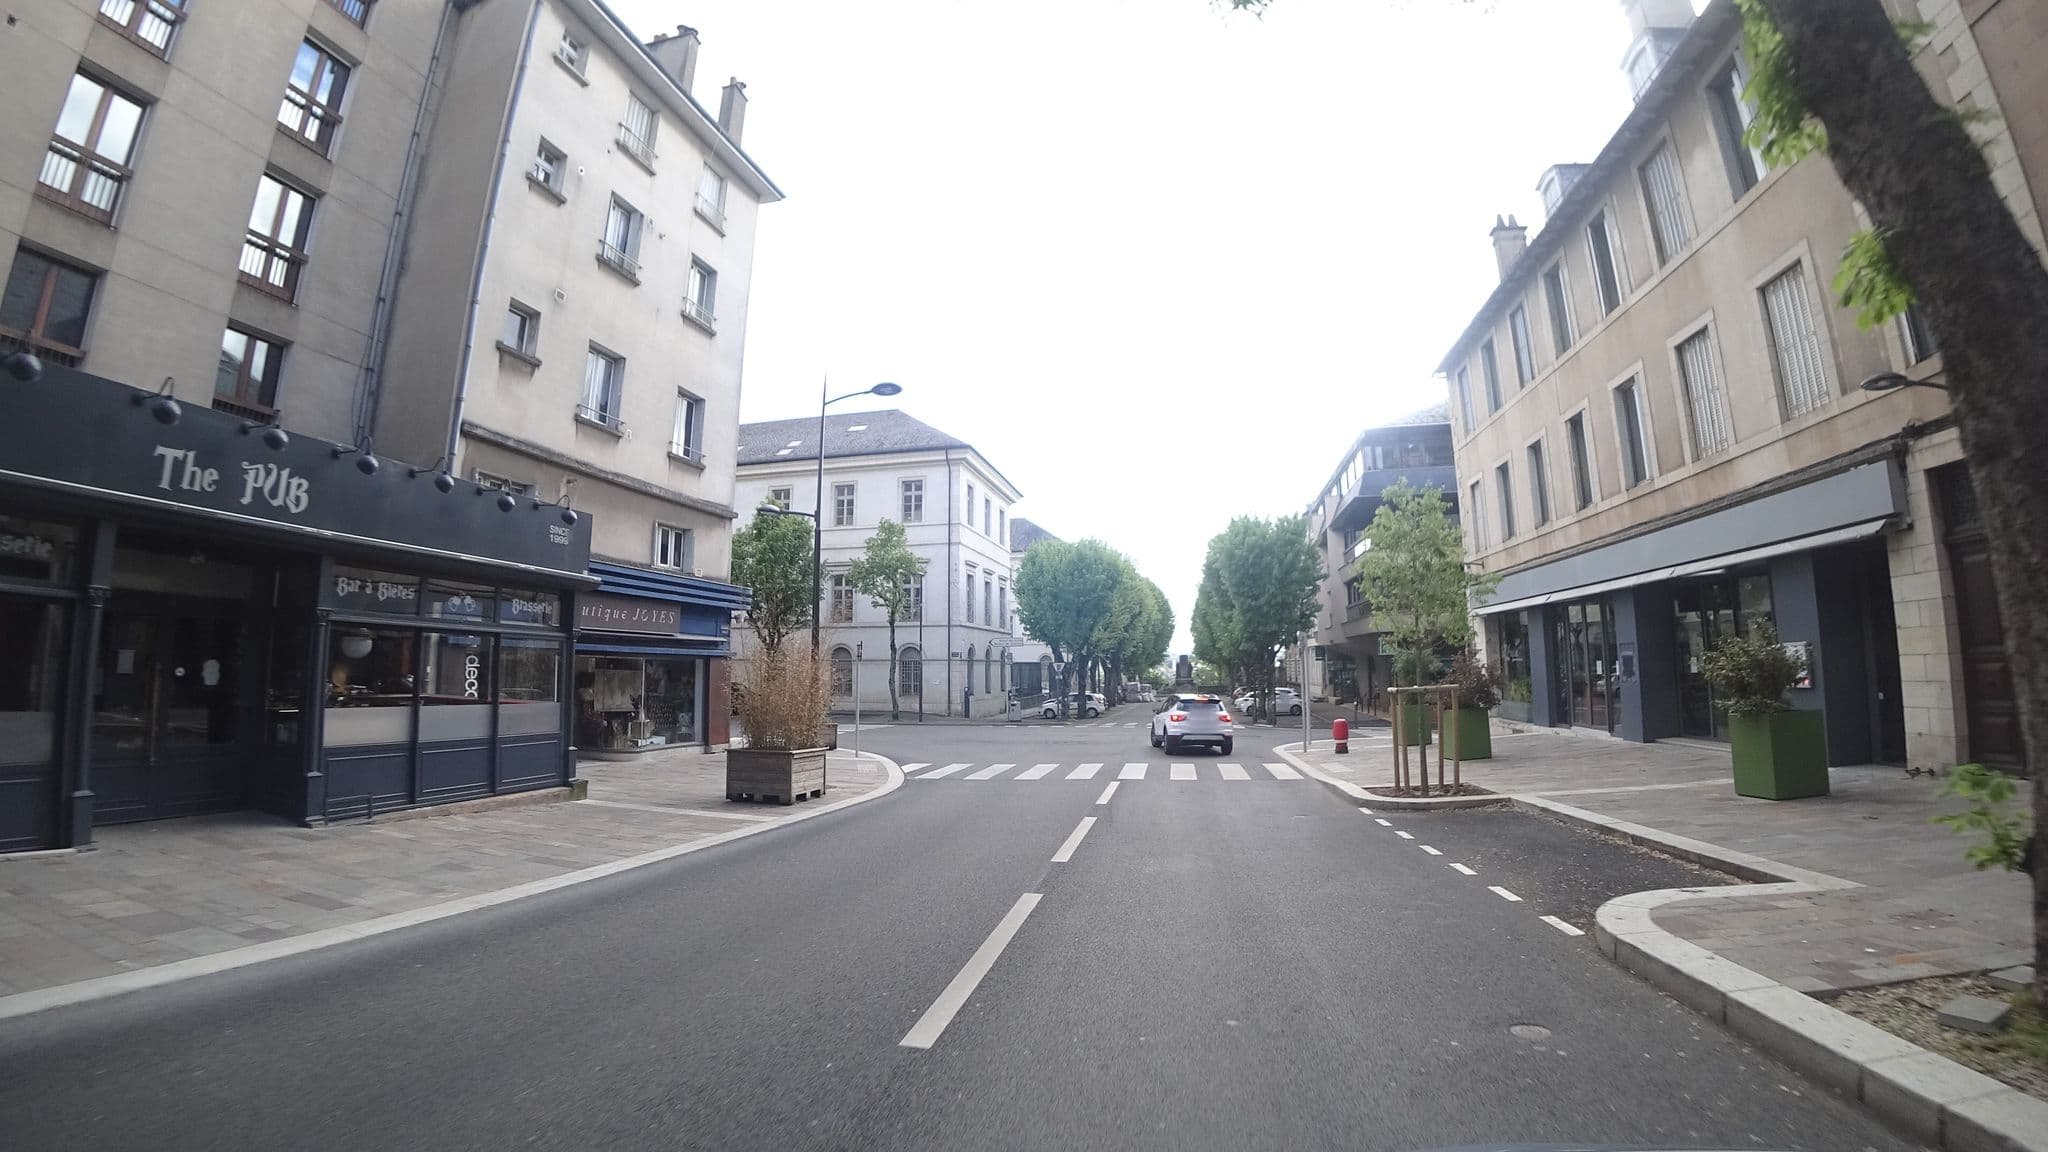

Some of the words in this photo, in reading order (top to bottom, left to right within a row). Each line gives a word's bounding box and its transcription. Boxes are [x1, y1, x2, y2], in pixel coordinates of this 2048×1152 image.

[153, 445, 220, 492] The
[239, 461, 310, 514] PUB
[336, 577, 361, 597] Bar
[365, 580, 373, 594] à
[377, 582, 415, 601] Bières
[512, 598, 553, 615] Brasserie
[632, 607, 676, 624] JOYES
